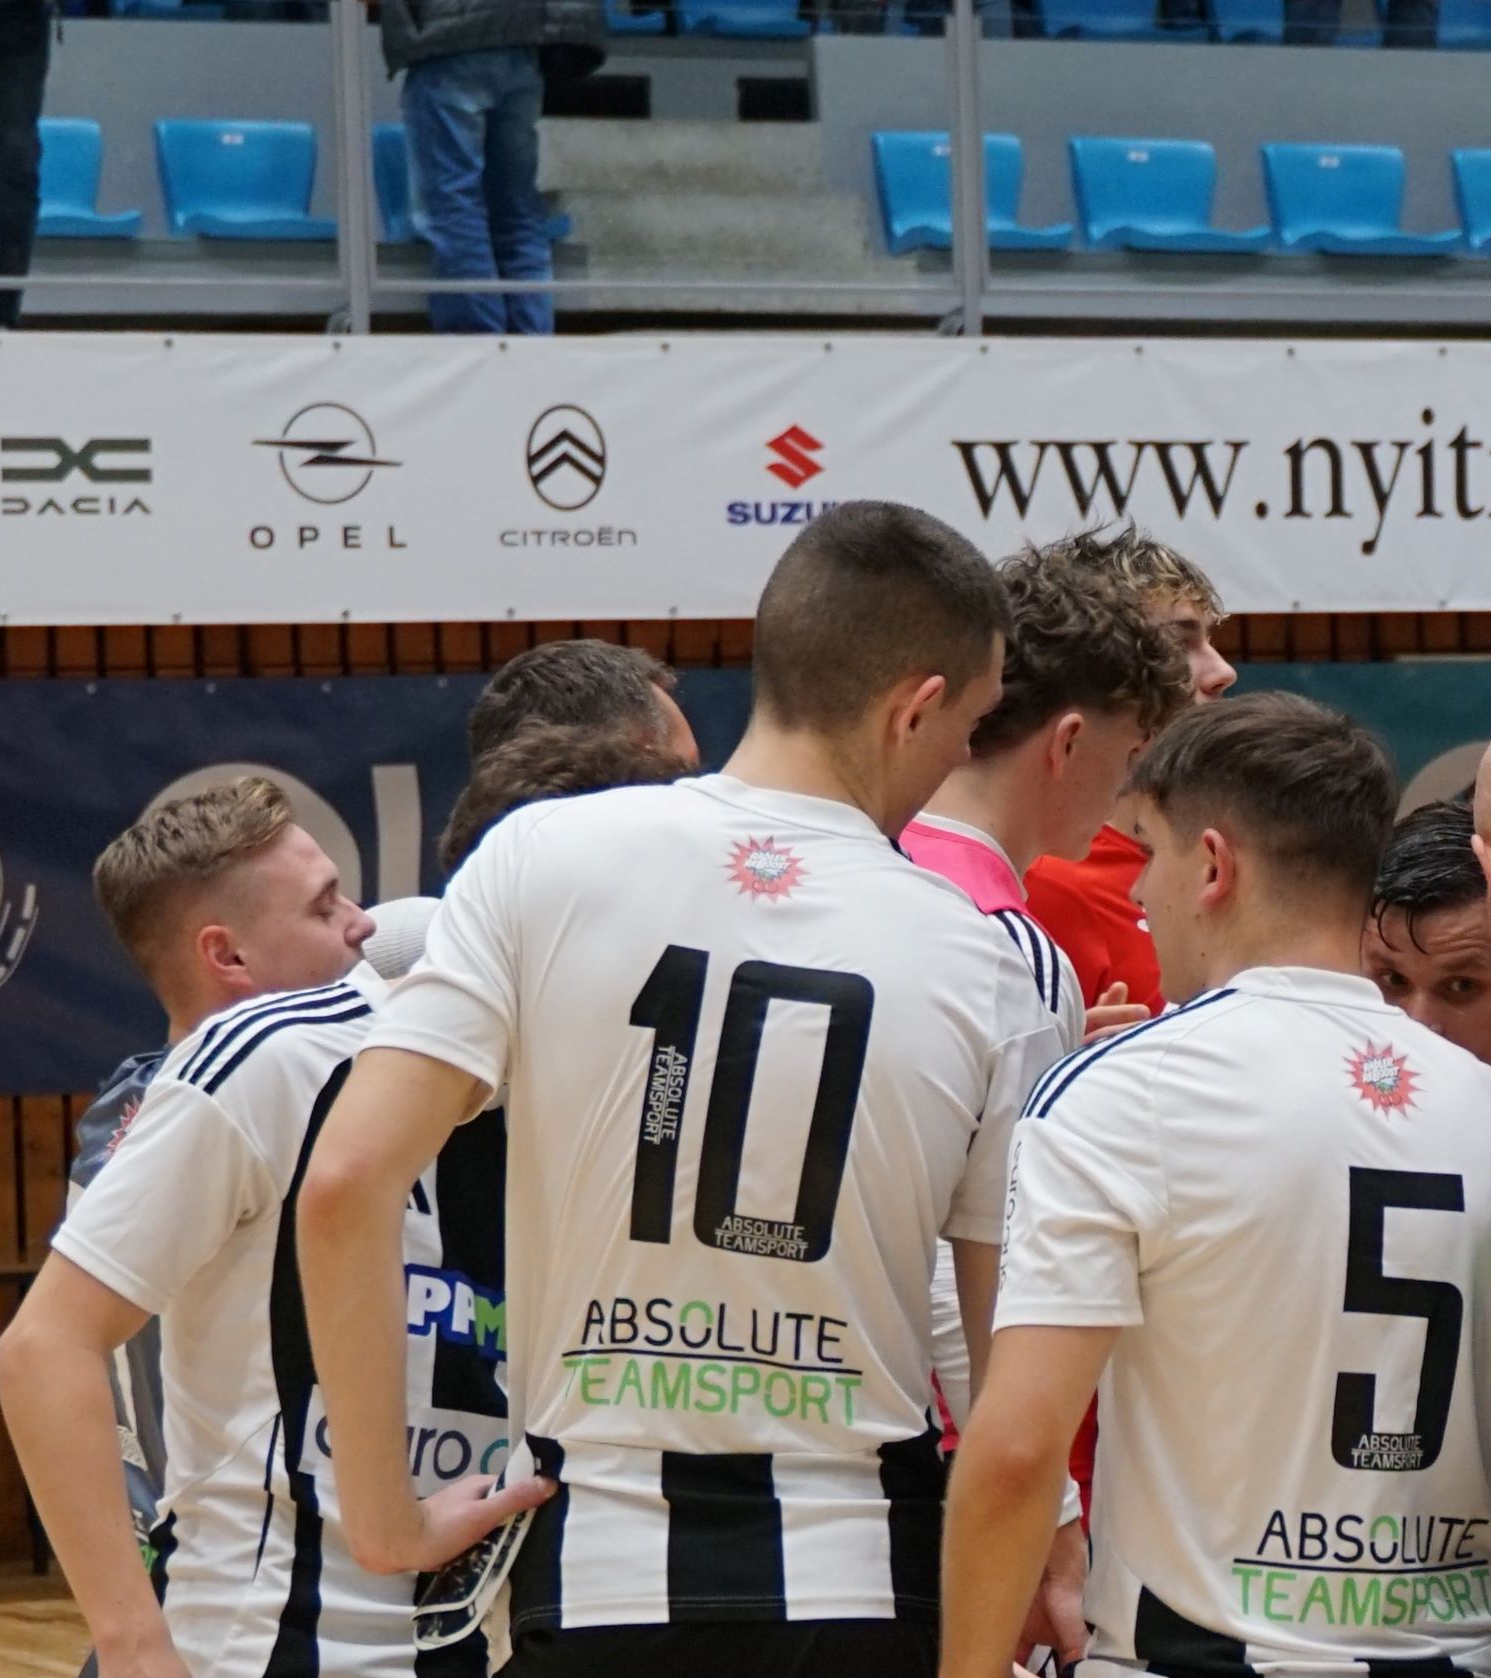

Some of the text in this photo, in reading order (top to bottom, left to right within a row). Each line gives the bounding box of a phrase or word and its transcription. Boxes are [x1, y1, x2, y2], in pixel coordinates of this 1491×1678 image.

[1, 497, 151, 516] DACIA
[250, 526, 407, 549] OPEL
[500, 526, 637, 548] CITROËN
[630, 944, 875, 1262] 10
[643, 1045, 677, 1145] TEAMSPORT
[662, 1051, 688, 1141] ABSOLUTE
[715, 1231, 808, 1260] TEAMSPORT
[721, 1215, 805, 1242] ABSOLUTE
[581, 1298, 848, 1364] ABSOLUTE
[1331, 1165, 1466, 1471] 5
[563, 1358, 862, 1427] TEAMSPORT
[1256, 1510, 1490, 1563] ABSOLUTE
